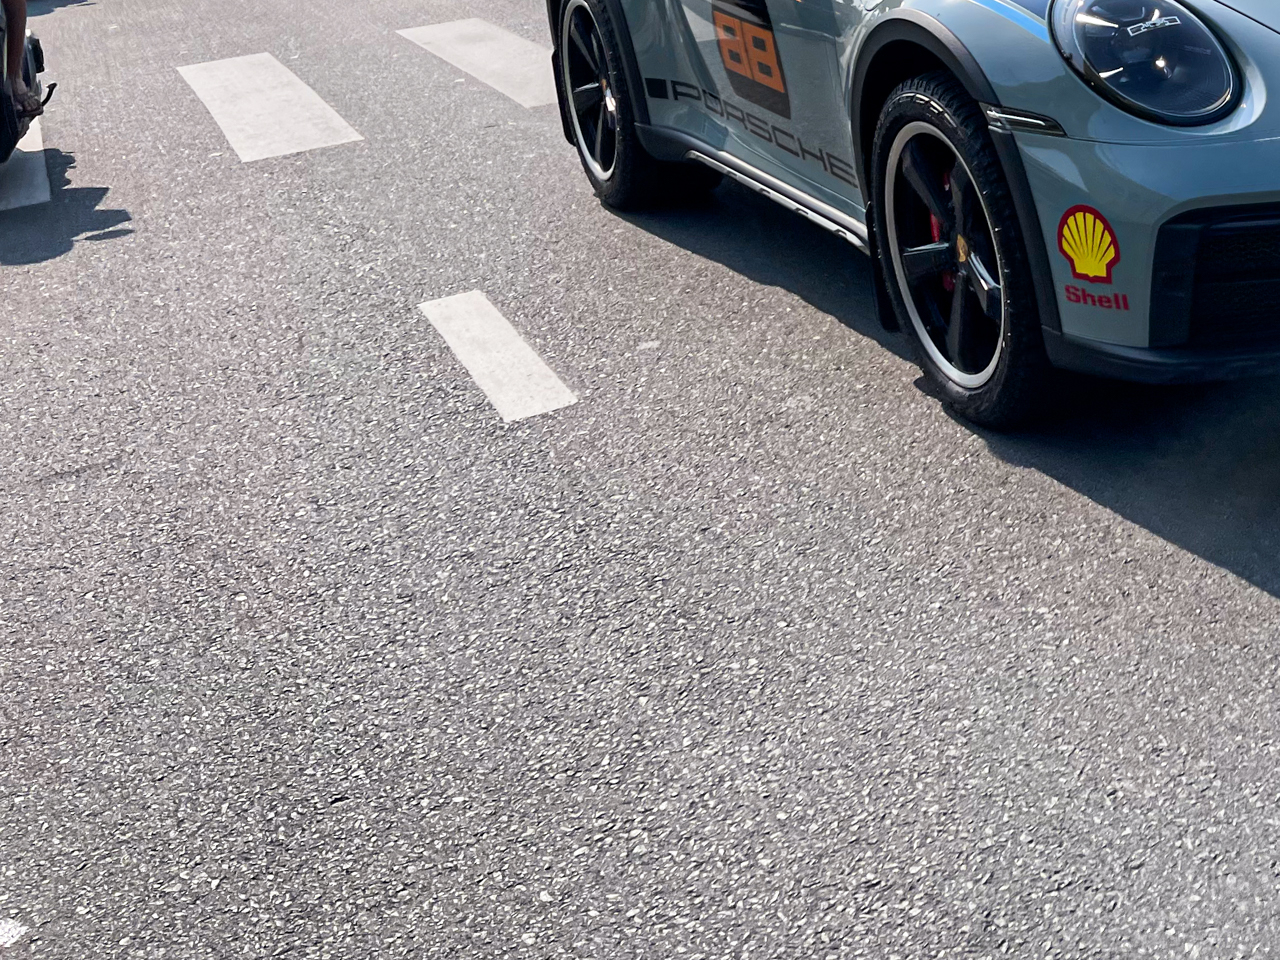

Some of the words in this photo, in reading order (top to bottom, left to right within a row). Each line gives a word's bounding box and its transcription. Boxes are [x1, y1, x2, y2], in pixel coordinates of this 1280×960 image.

[713, 10, 785, 93] 88
[671, 80, 859, 189] PORSCHE
[1064, 284, 1129, 311] Shell
